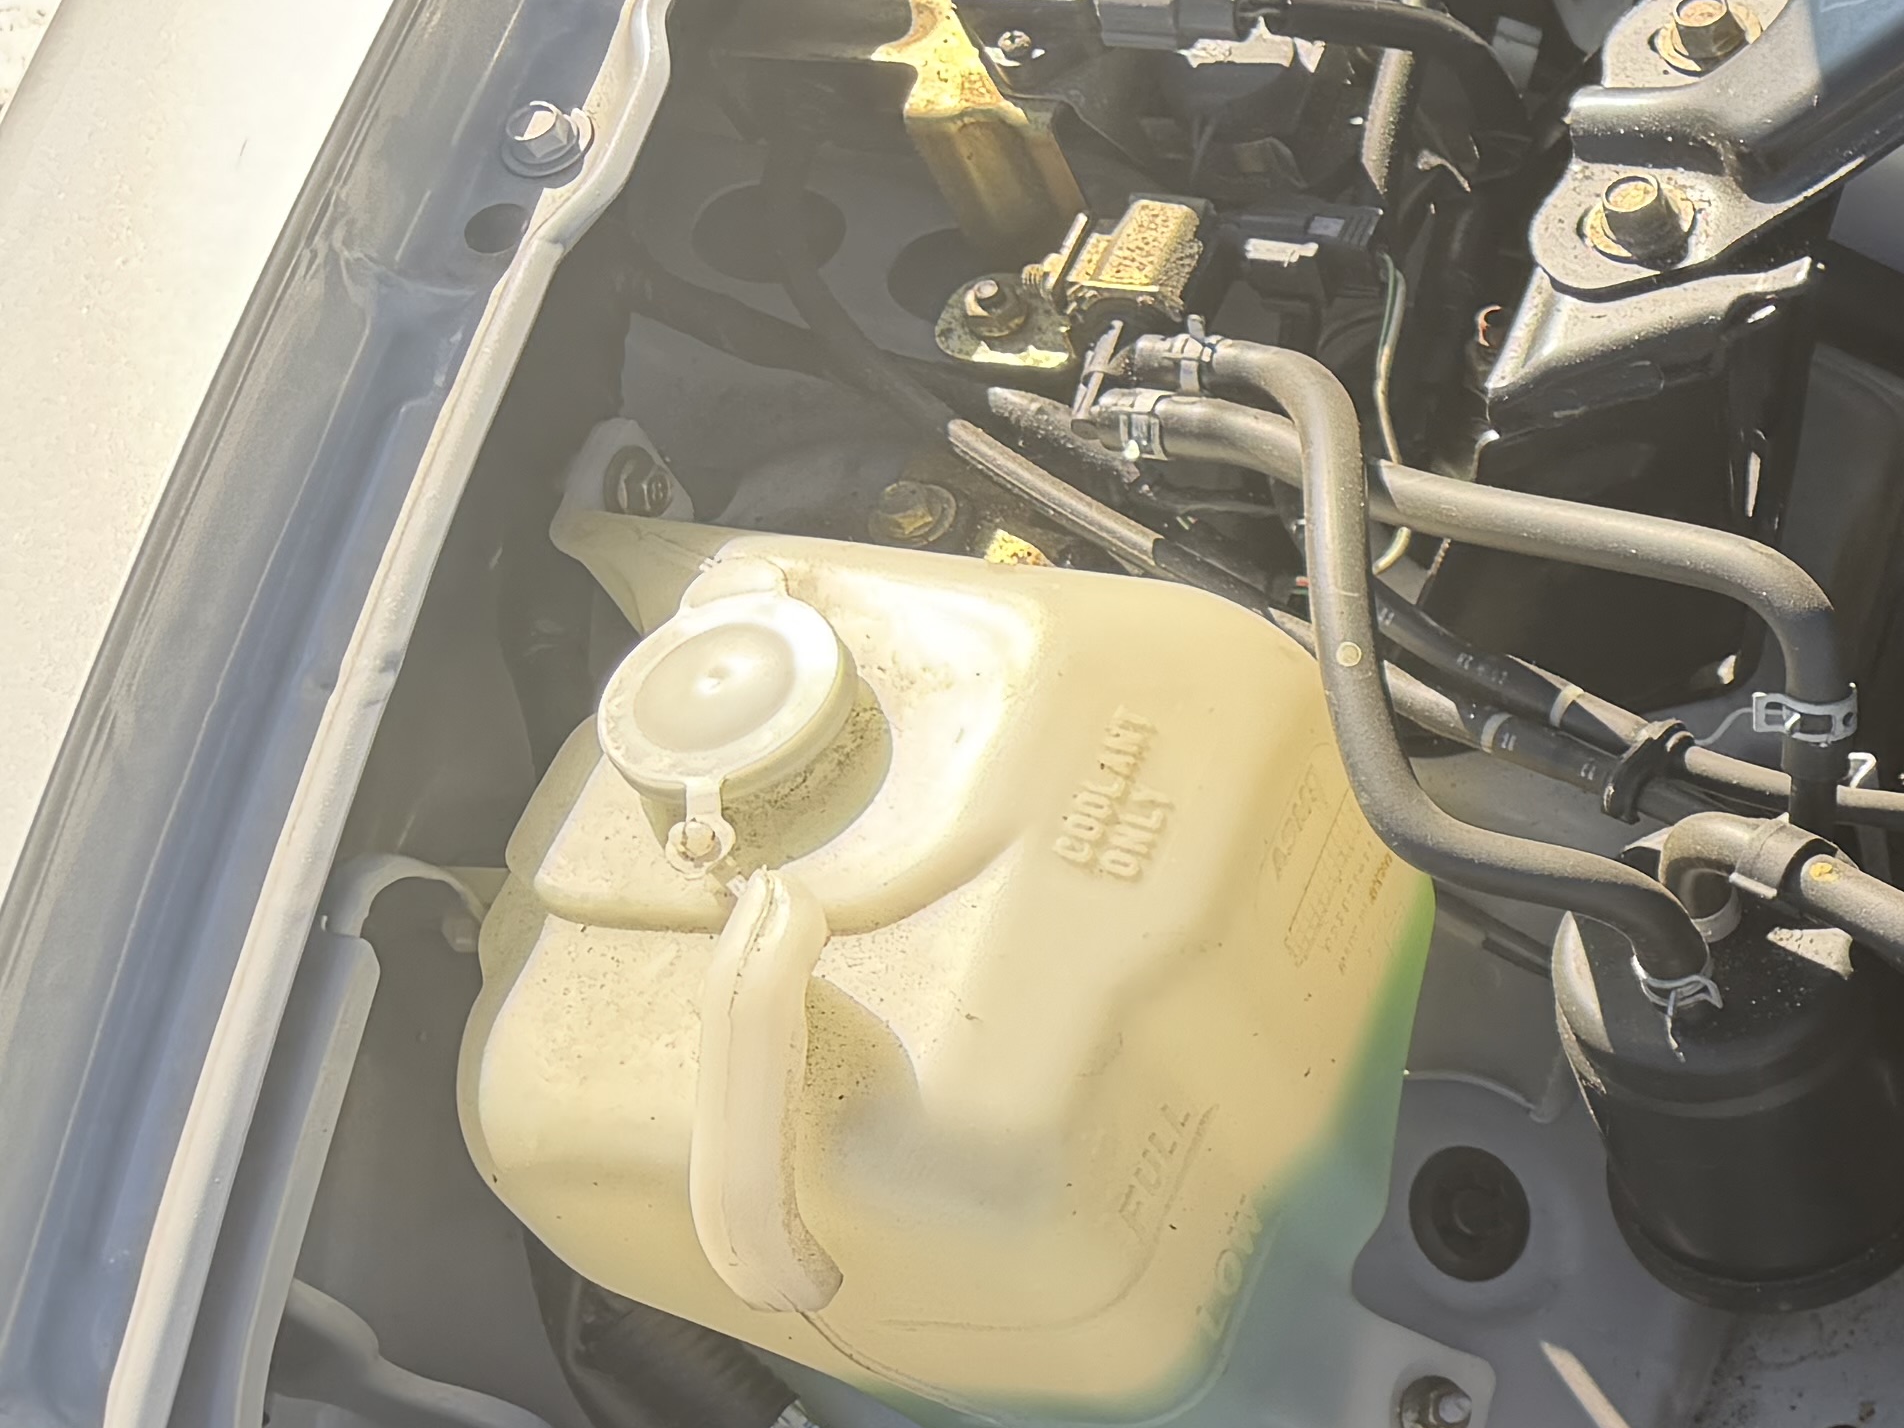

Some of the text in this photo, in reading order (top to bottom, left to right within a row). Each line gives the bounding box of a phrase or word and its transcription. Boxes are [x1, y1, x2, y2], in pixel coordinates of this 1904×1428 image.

[1052, 704, 1157, 865] COOLANT
[1100, 782, 1175, 883] ONLY
[1118, 1103, 1192, 1244] FULL
